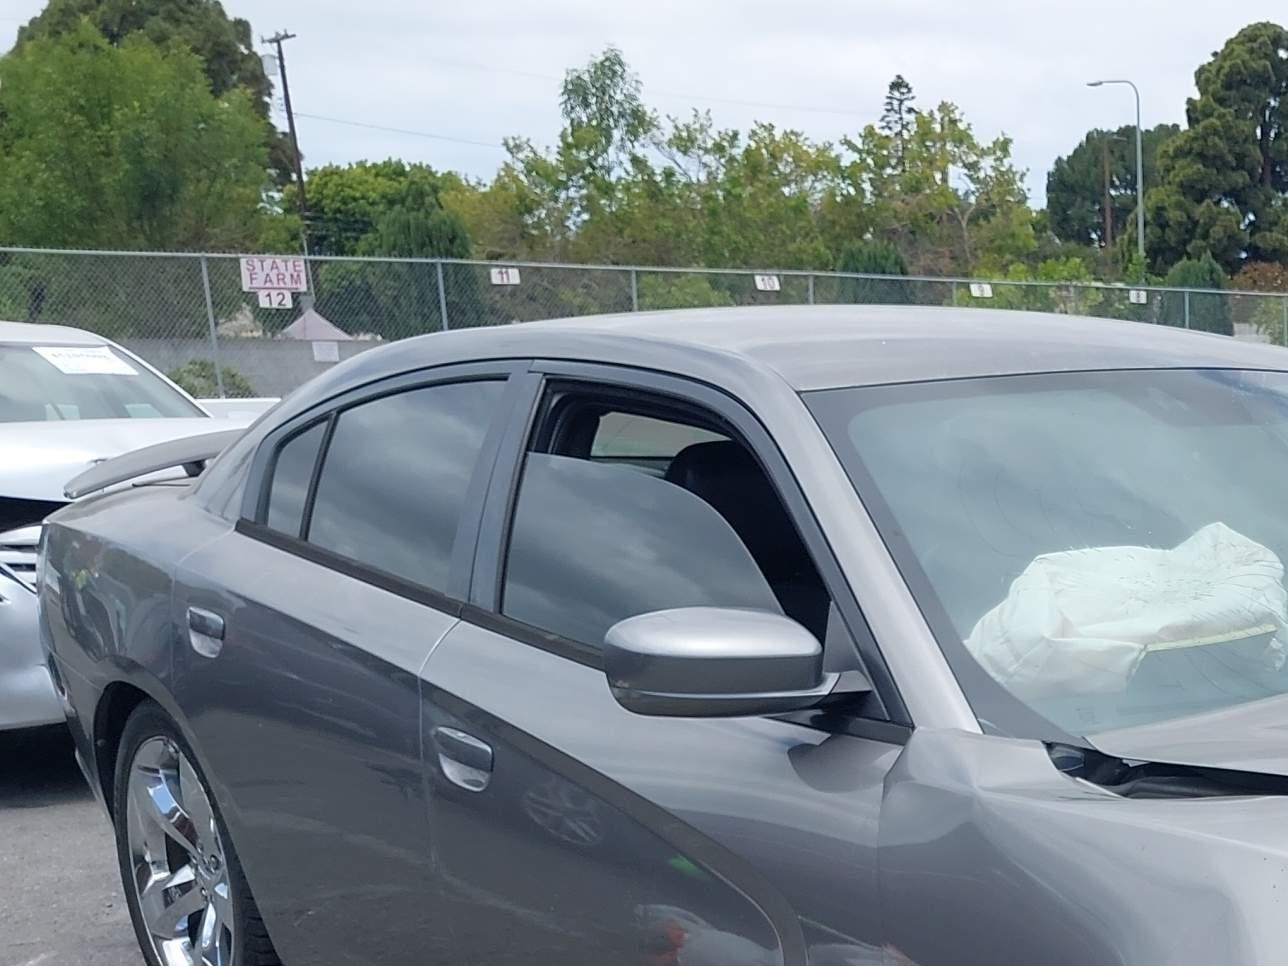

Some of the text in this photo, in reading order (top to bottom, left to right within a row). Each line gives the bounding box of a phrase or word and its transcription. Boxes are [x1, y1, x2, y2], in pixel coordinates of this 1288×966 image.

[246, 259, 303, 273] STATE
[249, 272, 302, 286] FARM
[761, 276, 776, 290] 10
[265, 292, 287, 307] 12
